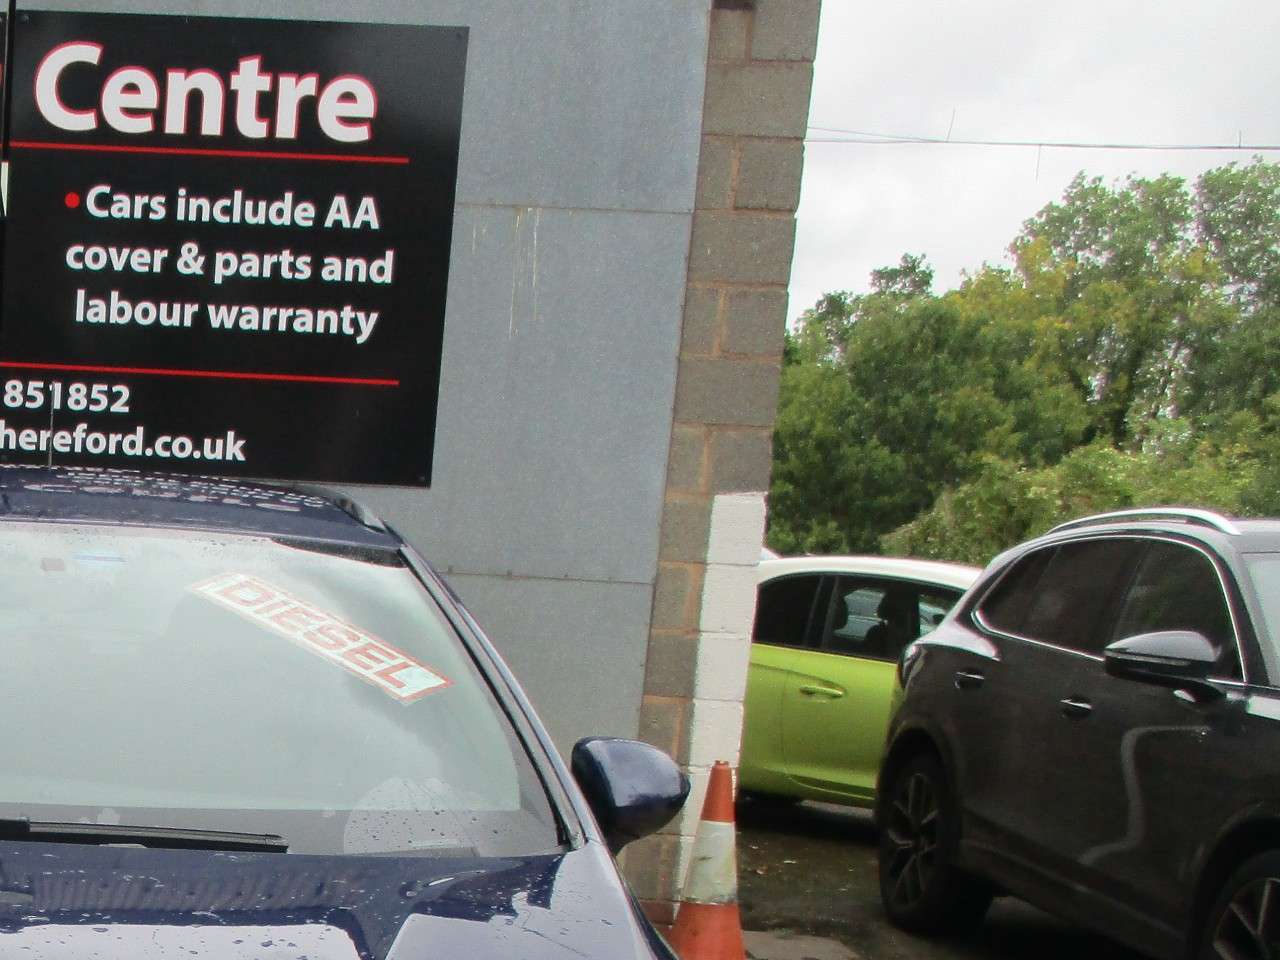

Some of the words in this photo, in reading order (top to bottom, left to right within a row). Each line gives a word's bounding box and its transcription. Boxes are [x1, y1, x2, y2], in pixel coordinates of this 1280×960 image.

[34, 41, 376, 143] Centre
[86, 185, 167, 220] Cars
[176, 187, 316, 227] include
[324, 195, 380, 230] AA
[65, 245, 169, 273] cover
[176, 242, 205, 275] &
[214, 249, 312, 284] parts
[321, 250, 394, 284] and
[75, 288, 199, 327] labour
[207, 304, 379, 345] warranty
[3, 379, 130, 413] 851852
[220, 579, 416, 690] DIESEL
